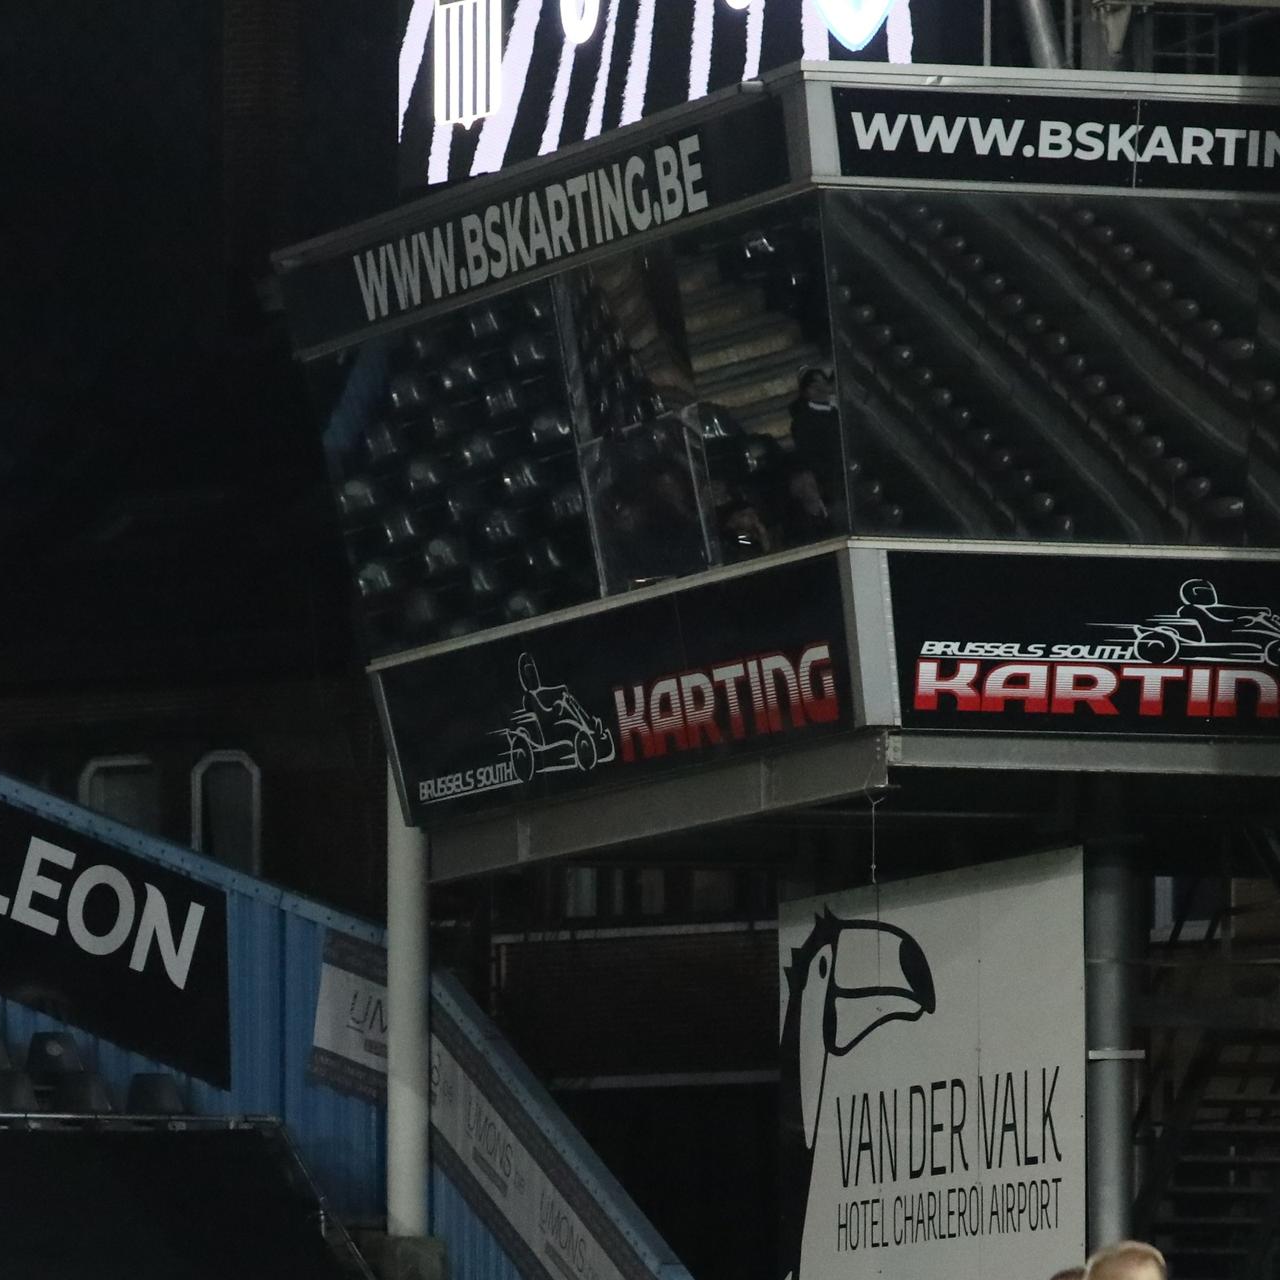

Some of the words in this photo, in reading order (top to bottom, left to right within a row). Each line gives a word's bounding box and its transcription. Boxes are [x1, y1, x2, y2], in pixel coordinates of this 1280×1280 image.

[354, 134, 709, 321] WWW.BSKARTING.BE
[613, 642, 840, 763] KARTING
[921, 640, 1044, 658] BRUSSELS
[1049, 643, 1134, 660] SOUTH
[836, 1088, 899, 1189] VAN
[909, 1078, 969, 1180] DER
[978, 1065, 1063, 1170] VALK
[836, 1198, 889, 1252] HOTEL
[892, 1185, 984, 1246] CHARLEROI
[989, 1177, 1063, 1237] AIRPORT
